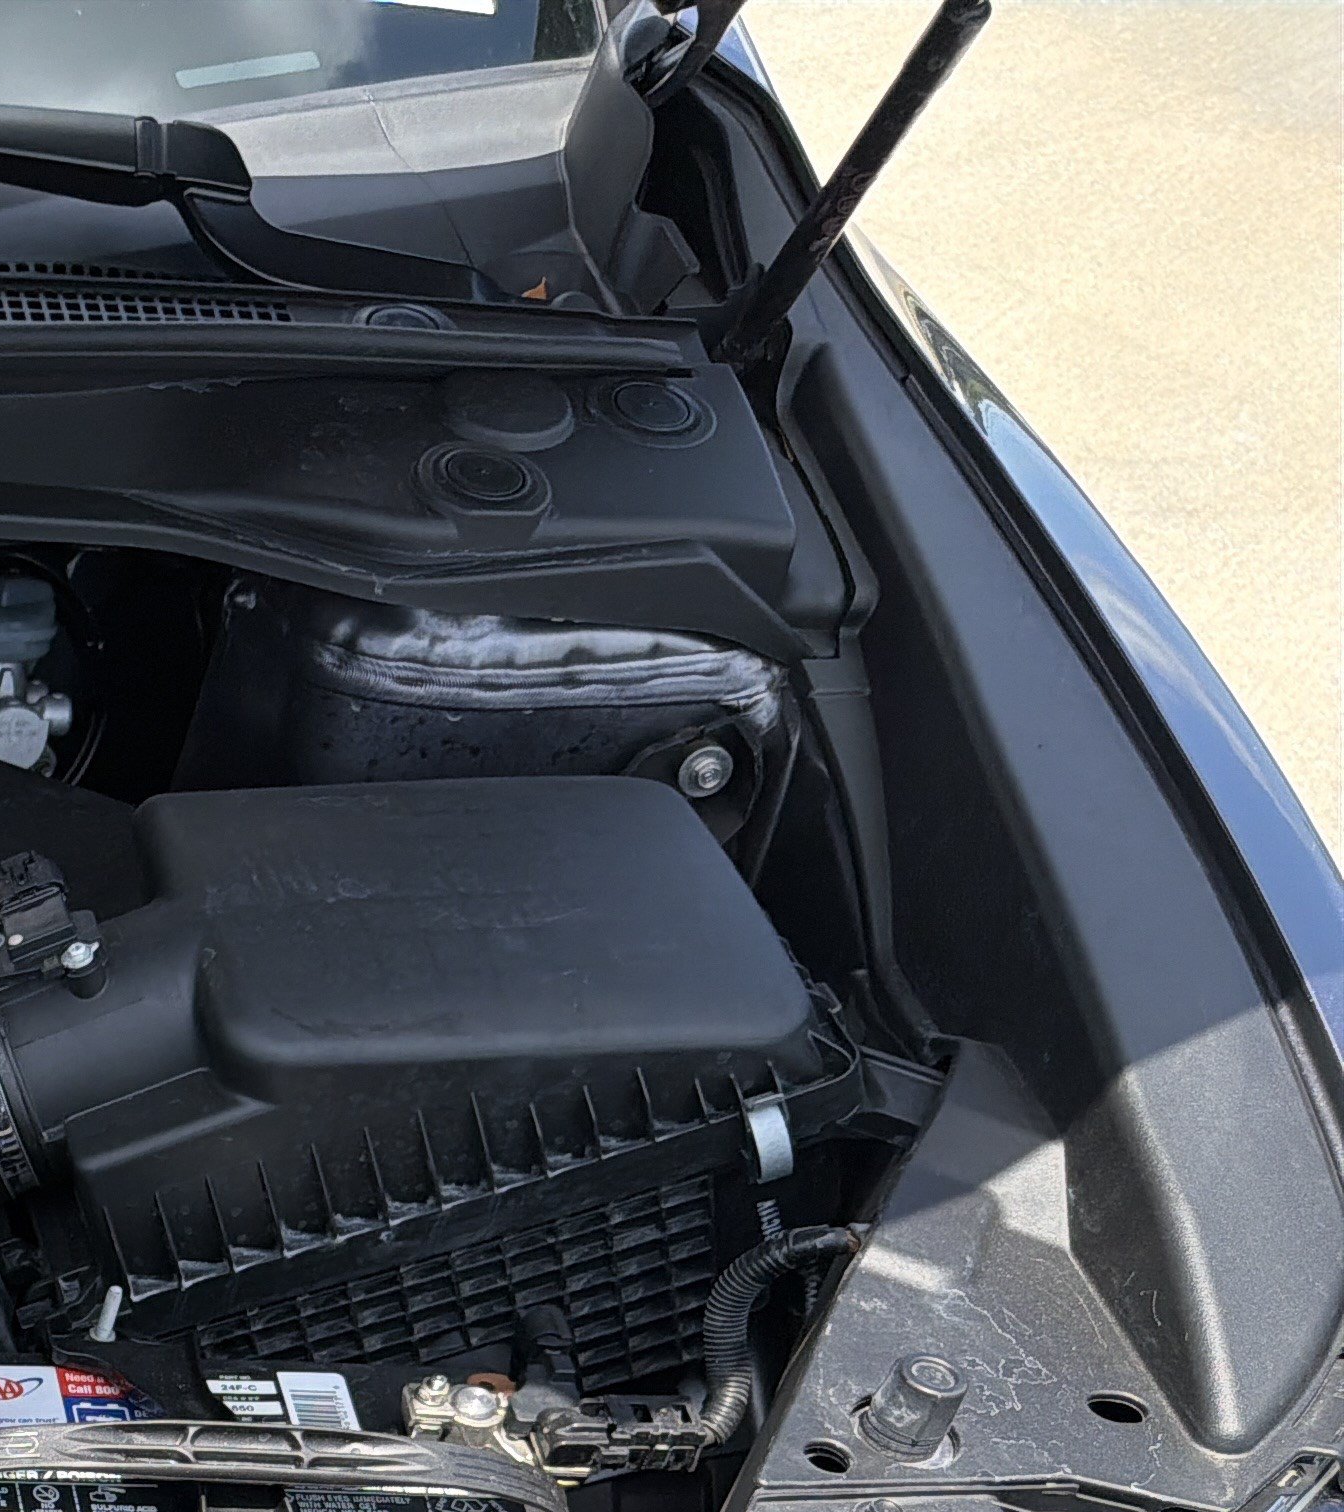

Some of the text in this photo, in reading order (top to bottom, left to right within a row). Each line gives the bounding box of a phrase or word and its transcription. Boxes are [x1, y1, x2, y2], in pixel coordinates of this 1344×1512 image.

[65, 1372, 94, 1382] Need
[68, 1384, 92, 1394] Call
[0, 1416, 15, 1424] you
